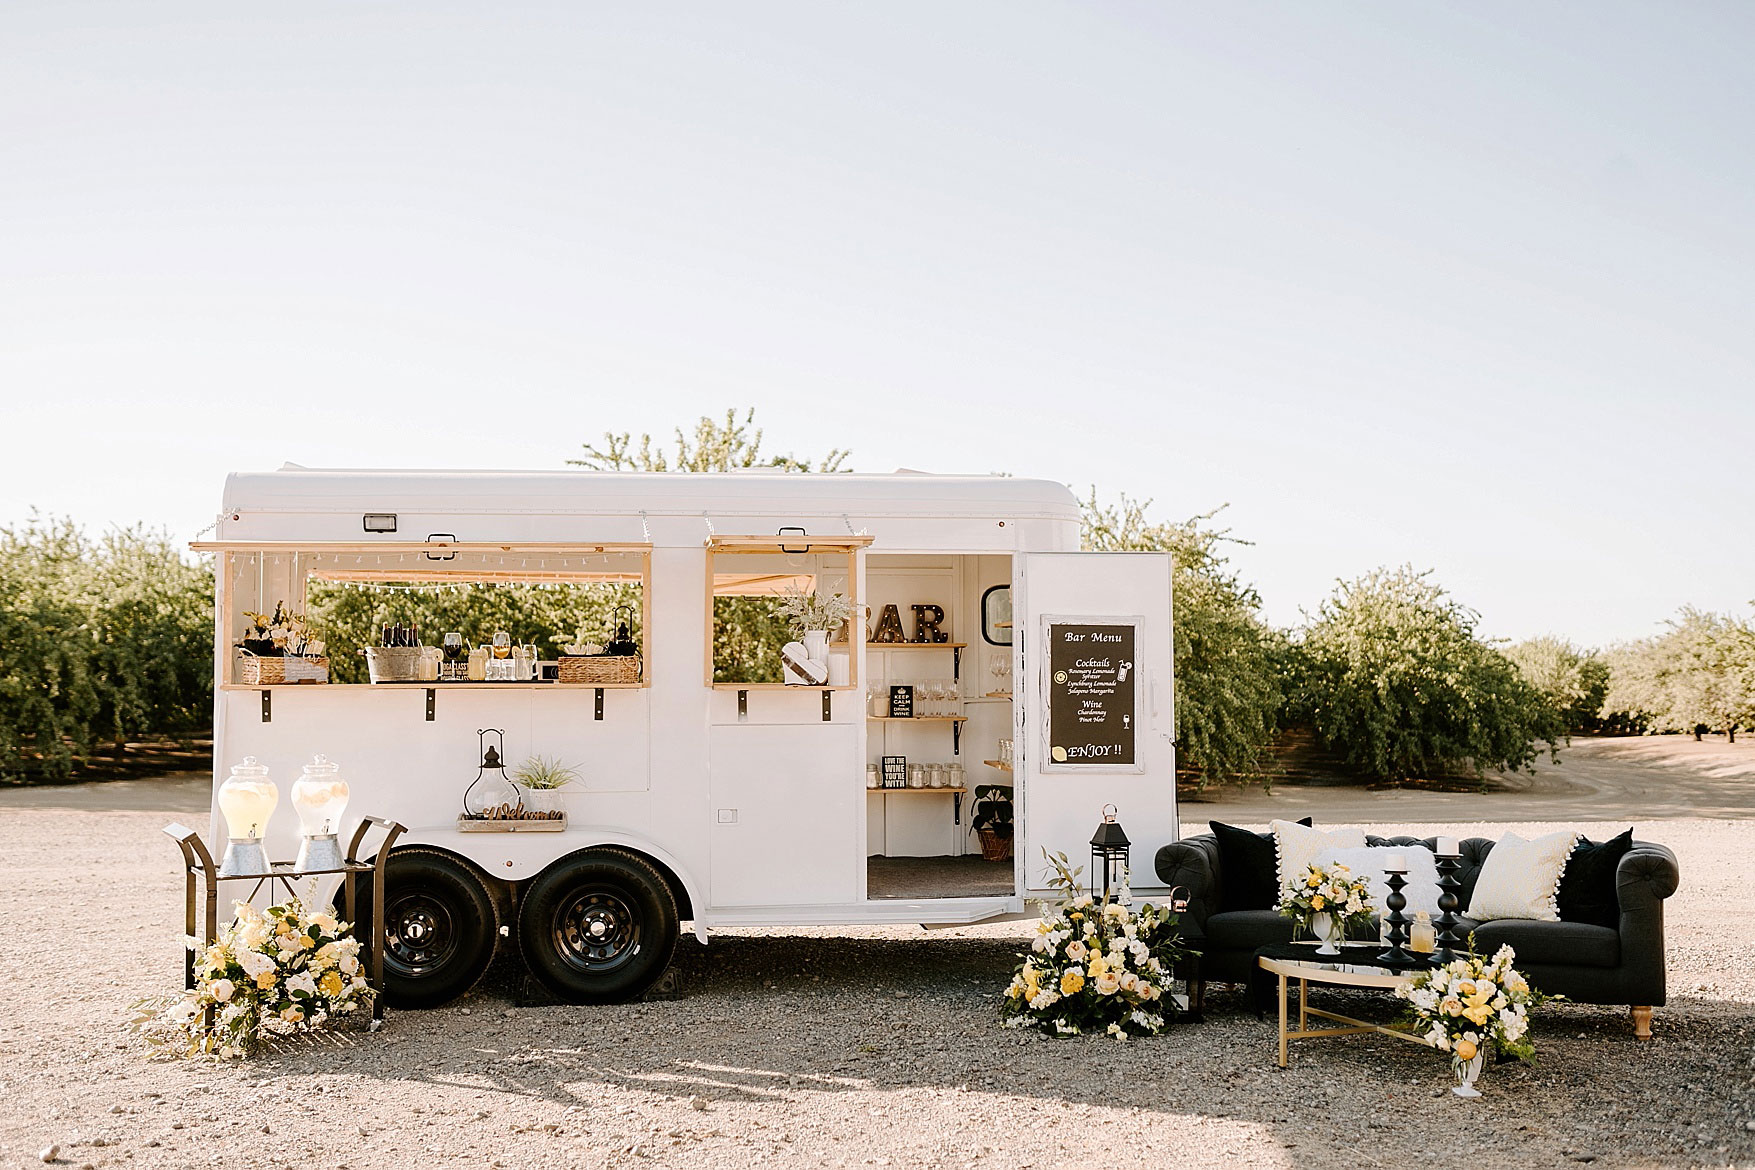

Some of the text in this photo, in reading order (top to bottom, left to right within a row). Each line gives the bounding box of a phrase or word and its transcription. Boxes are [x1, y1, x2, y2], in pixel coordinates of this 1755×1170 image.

[1064, 632, 1122, 642] Bar Menu
[1075, 657, 1110, 668] Cocktails
[1068, 668, 1092, 676] Rosemary
[1067, 680, 1093, 689] Lynchburg
[1089, 688, 1115, 696] Margarita
[1081, 700, 1103, 709] Wine
[1077, 708, 1107, 717] Chardonnay
[1093, 715, 1105, 723] Noir
[1067, 743, 1112, 758] ENJOY
[884, 764, 905, 773] WINE
[884, 772, 905, 780] YOU'RE
[884, 779, 905, 788] WITH
[482, 802, 564, 821] Welcome
